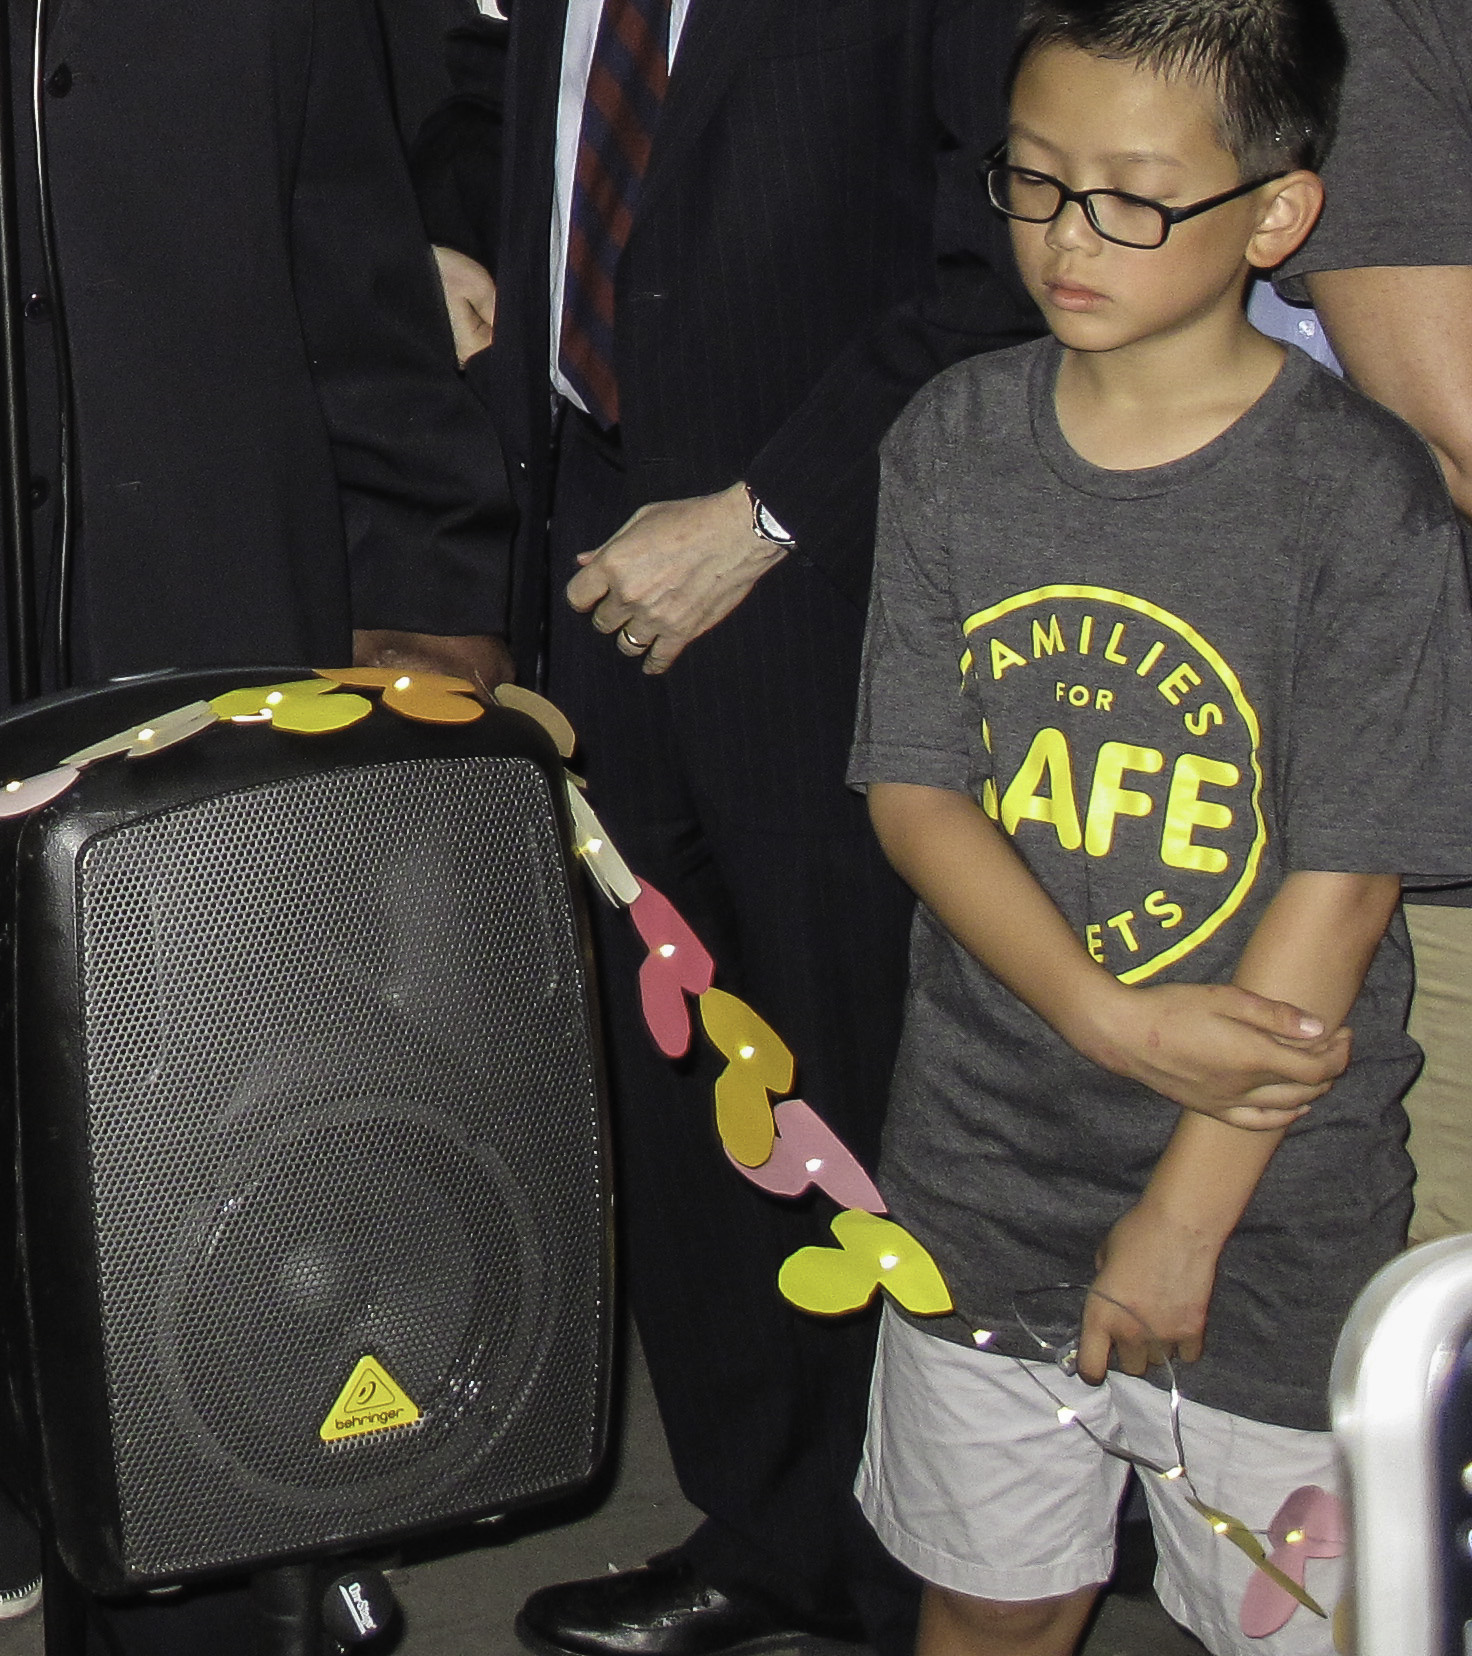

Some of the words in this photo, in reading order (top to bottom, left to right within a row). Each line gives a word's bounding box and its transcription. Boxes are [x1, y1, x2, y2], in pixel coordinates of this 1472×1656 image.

[960, 614, 1224, 737] AMILIES
[1055, 681, 1114, 713] FOR
[986, 727, 1242, 875] AFE
[335, 1407, 405, 1431] behringer
